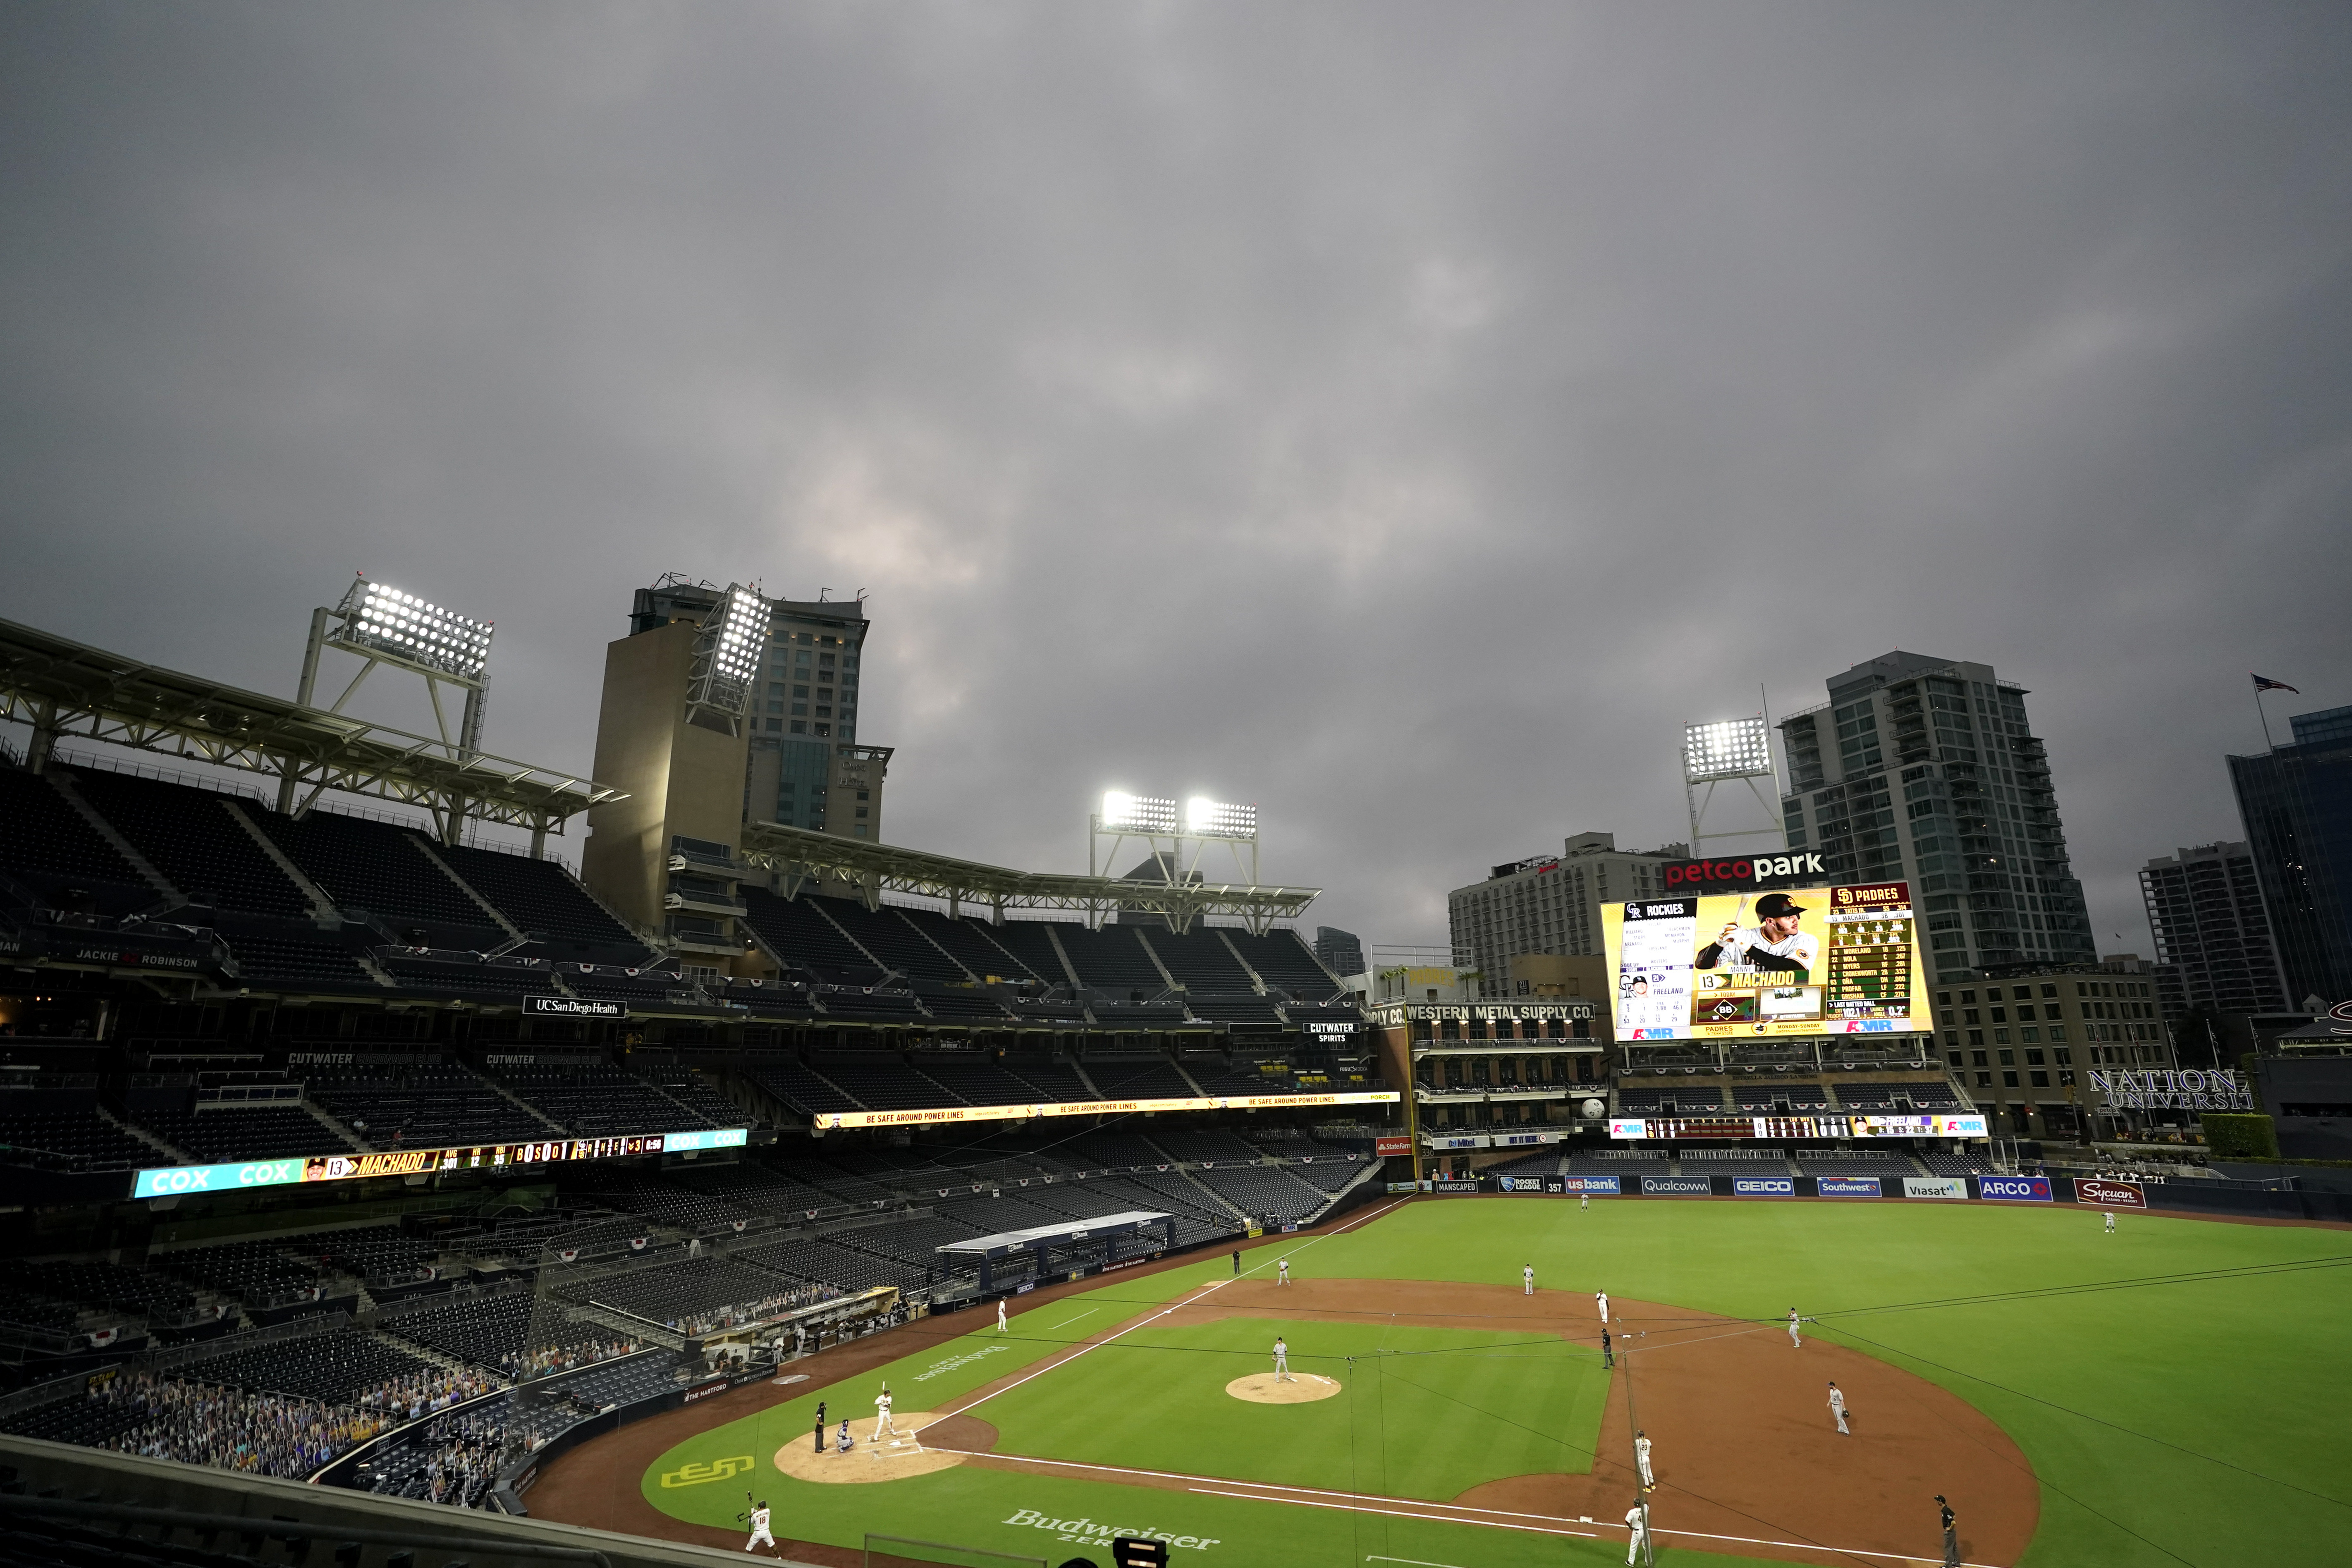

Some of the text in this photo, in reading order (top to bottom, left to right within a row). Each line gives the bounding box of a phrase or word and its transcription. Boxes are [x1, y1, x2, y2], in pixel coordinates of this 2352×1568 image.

[1855, 888, 1898, 901] PADRES
[1647, 904, 1684, 916] ROCKIES
[76, 950, 119, 961] JACKIE
[142, 955, 198, 968] ROBINSON
[1702, 970, 1795, 988] 13 MACHADO
[537, 999, 617, 1015] UC San Diego Health
[1406, 1005, 1594, 1020] WESTERN METAL SUPPLY CO.
[1310, 1023, 1353, 1033] CUTWATER
[1846, 1020, 1893, 1032] AMR
[1633, 1028, 1674, 1039] AMR
[289, 1053, 442, 1064] CUTWATER CORONADO CLUB
[487, 1055, 601, 1065] CUTWATER CORONADO CLUB
[896, 1113, 923, 1121] AROUND
[924, 1112, 945, 1120] POWER
[1886, 1116, 1921, 1125] FREELAND
[1613, 1124, 1643, 1133] AMR
[1948, 1121, 1983, 1131] AMR
[646, 1139, 661, 1150] 6:56
[671, 1132, 741, 1148] COX COX
[1457, 1138, 1475, 1147] Mitel
[330, 1160, 342, 1176] 13
[357, 1152, 426, 1175] MACHADO
[445, 1150, 457, 1158] AVG
[440, 1154, 505, 1170] .301 12 35
[152, 1162, 291, 1193] COX COX
[1549, 1183, 1561, 1192] 357
[1645, 1179, 1708, 1191] Qualcomm
[1737, 1181, 1791, 1192] GEICO
[1822, 1183, 1870, 1192] Southwest
[1983, 1183, 2030, 1195] ARCO
[1910, 1186, 1947, 1196] Viasat
[2083, 1183, 2135, 1201] Sycuan
[1018, 1283, 1033, 1293] GEICO
[911, 1346, 1010, 1382] Budweiser
[700, 1384, 727, 1397] HARTFORD
[760, 1516, 766, 1525] 18
